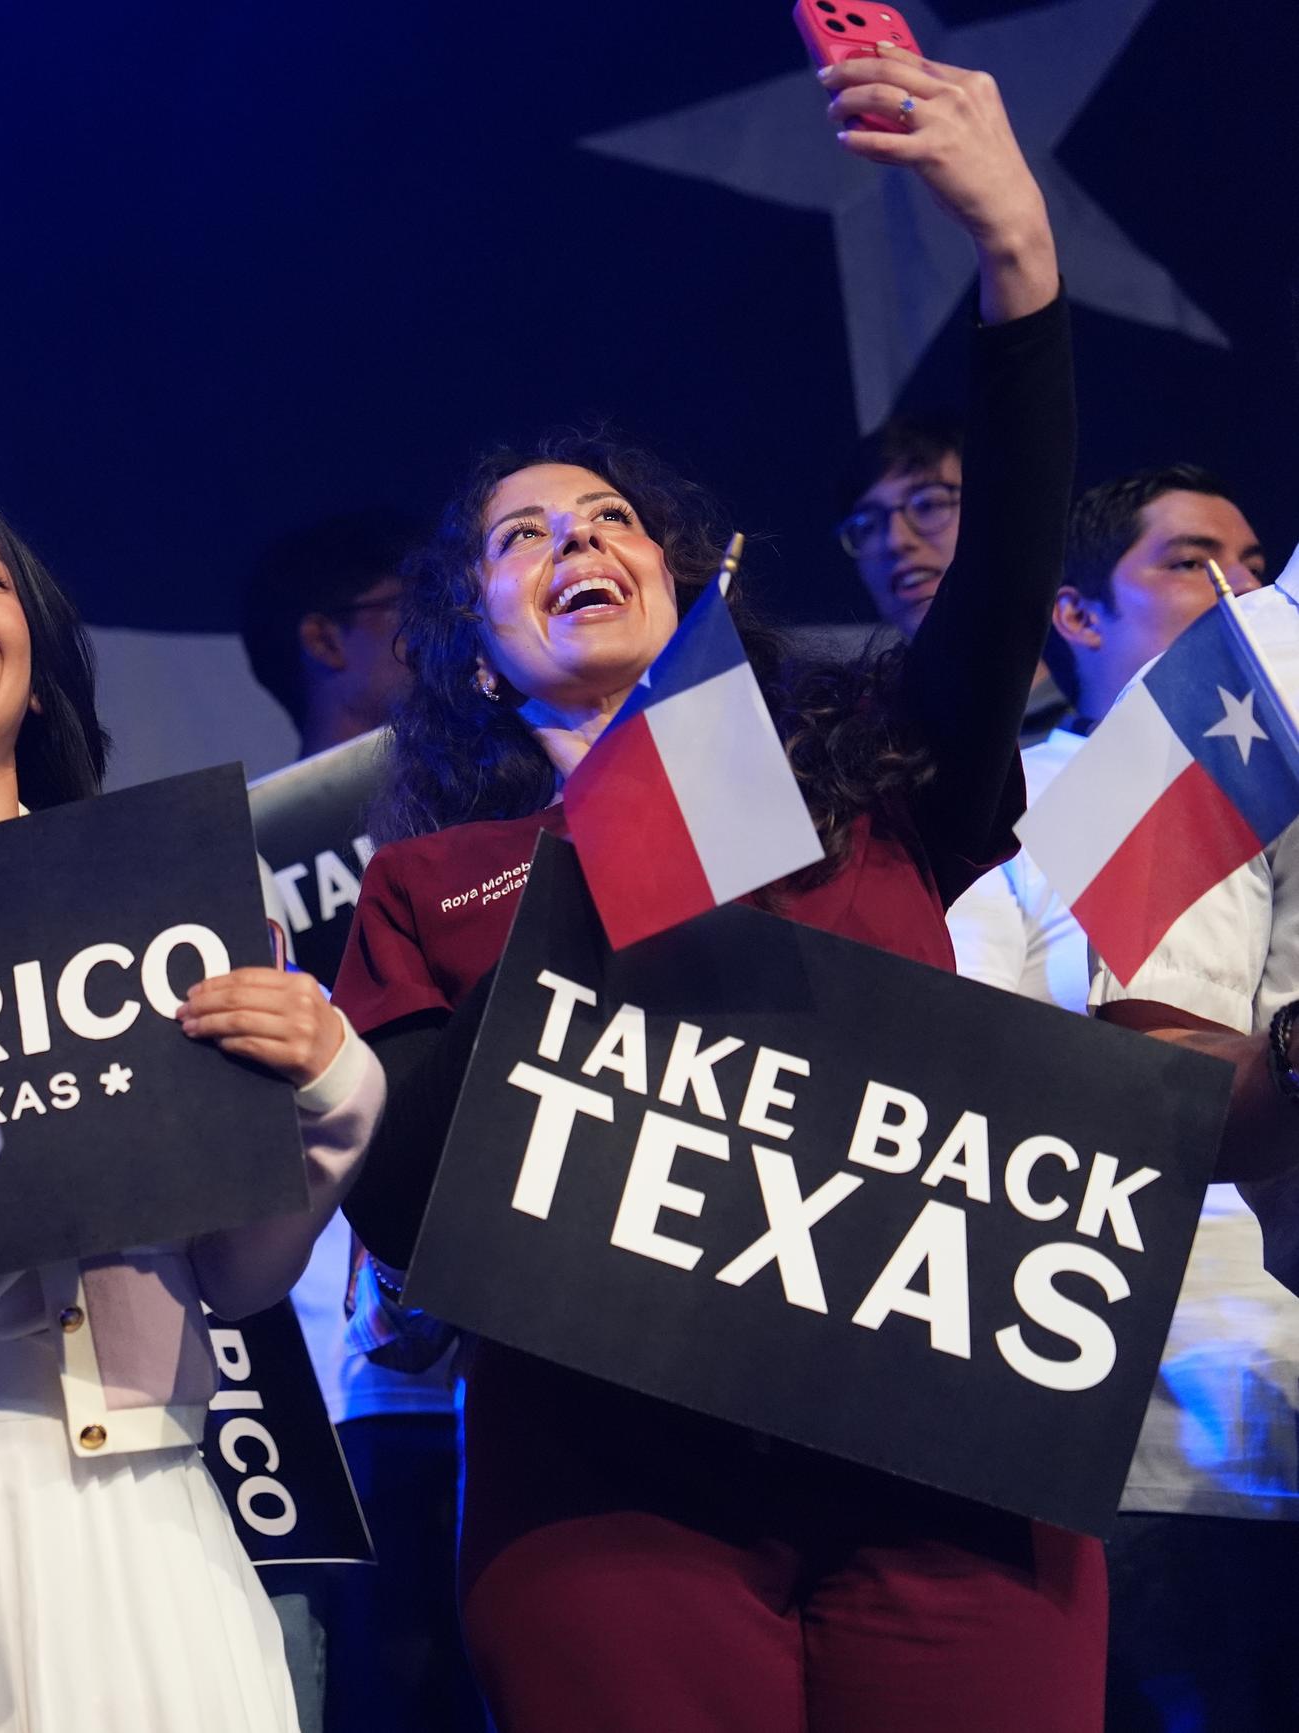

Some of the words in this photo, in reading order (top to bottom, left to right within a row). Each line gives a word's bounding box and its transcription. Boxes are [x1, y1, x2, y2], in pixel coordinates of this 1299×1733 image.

[441, 888, 479, 912] Roya
[482, 860, 534, 892] Moheb
[482, 874, 528, 905] Pediat
[507, 1062, 1133, 1392] TEXAS
[537, 970, 811, 1142] TAKE
[847, 1081, 1161, 1252] BACK
[203, 1301, 297, 1536] RICO
